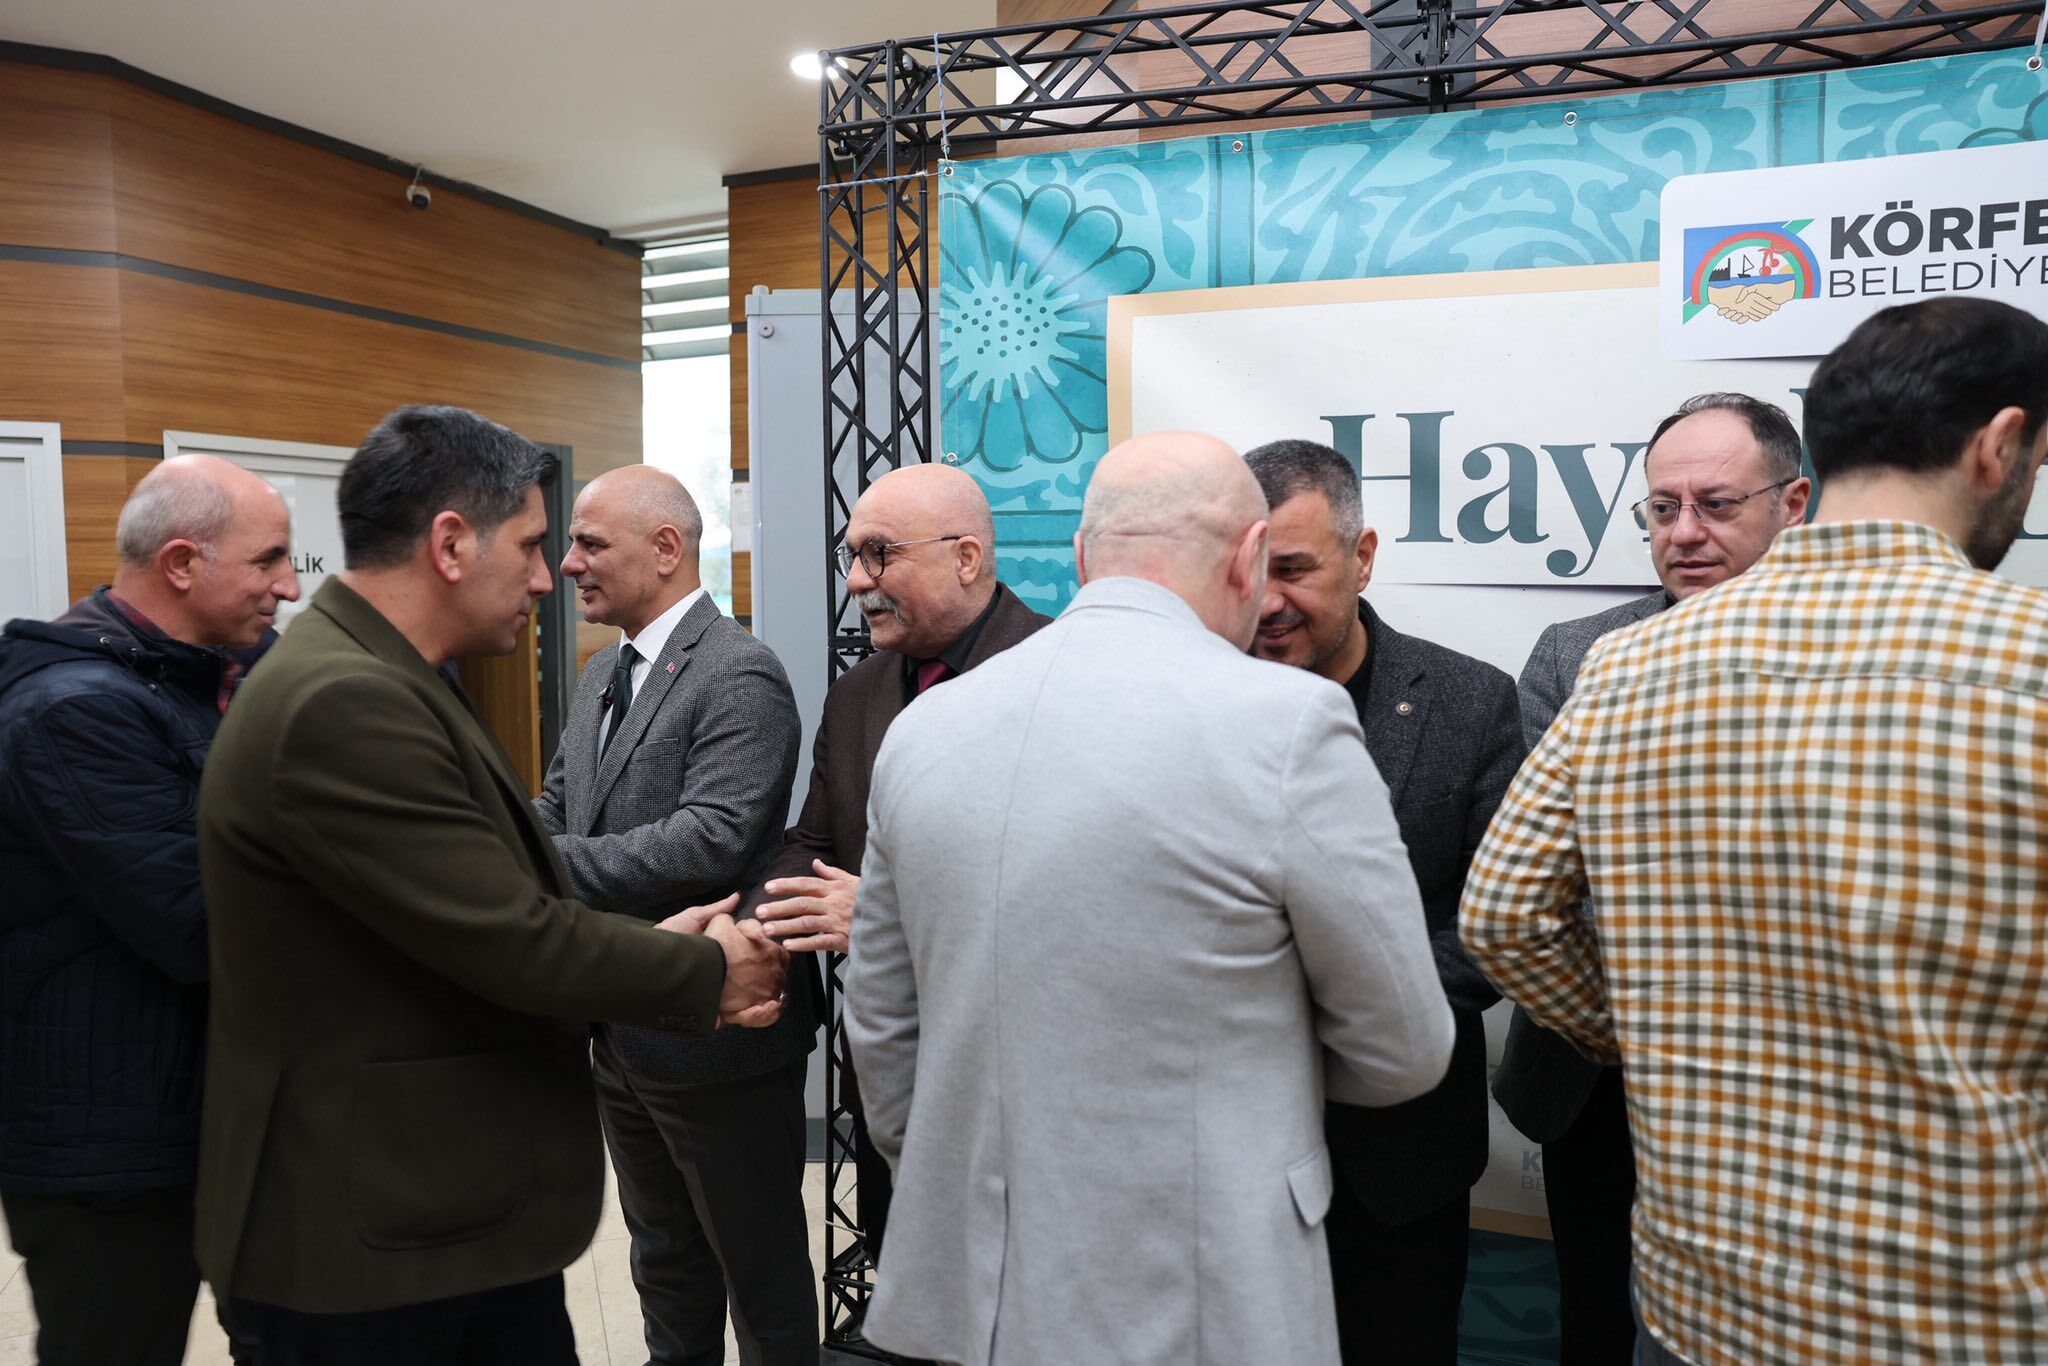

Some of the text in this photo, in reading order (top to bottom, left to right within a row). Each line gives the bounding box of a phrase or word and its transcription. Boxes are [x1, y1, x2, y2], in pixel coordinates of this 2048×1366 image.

[1829, 253, 2048, 298] BELEDİY
[1319, 410, 1650, 578] Hay
[288, 552, 325, 574] LİK
